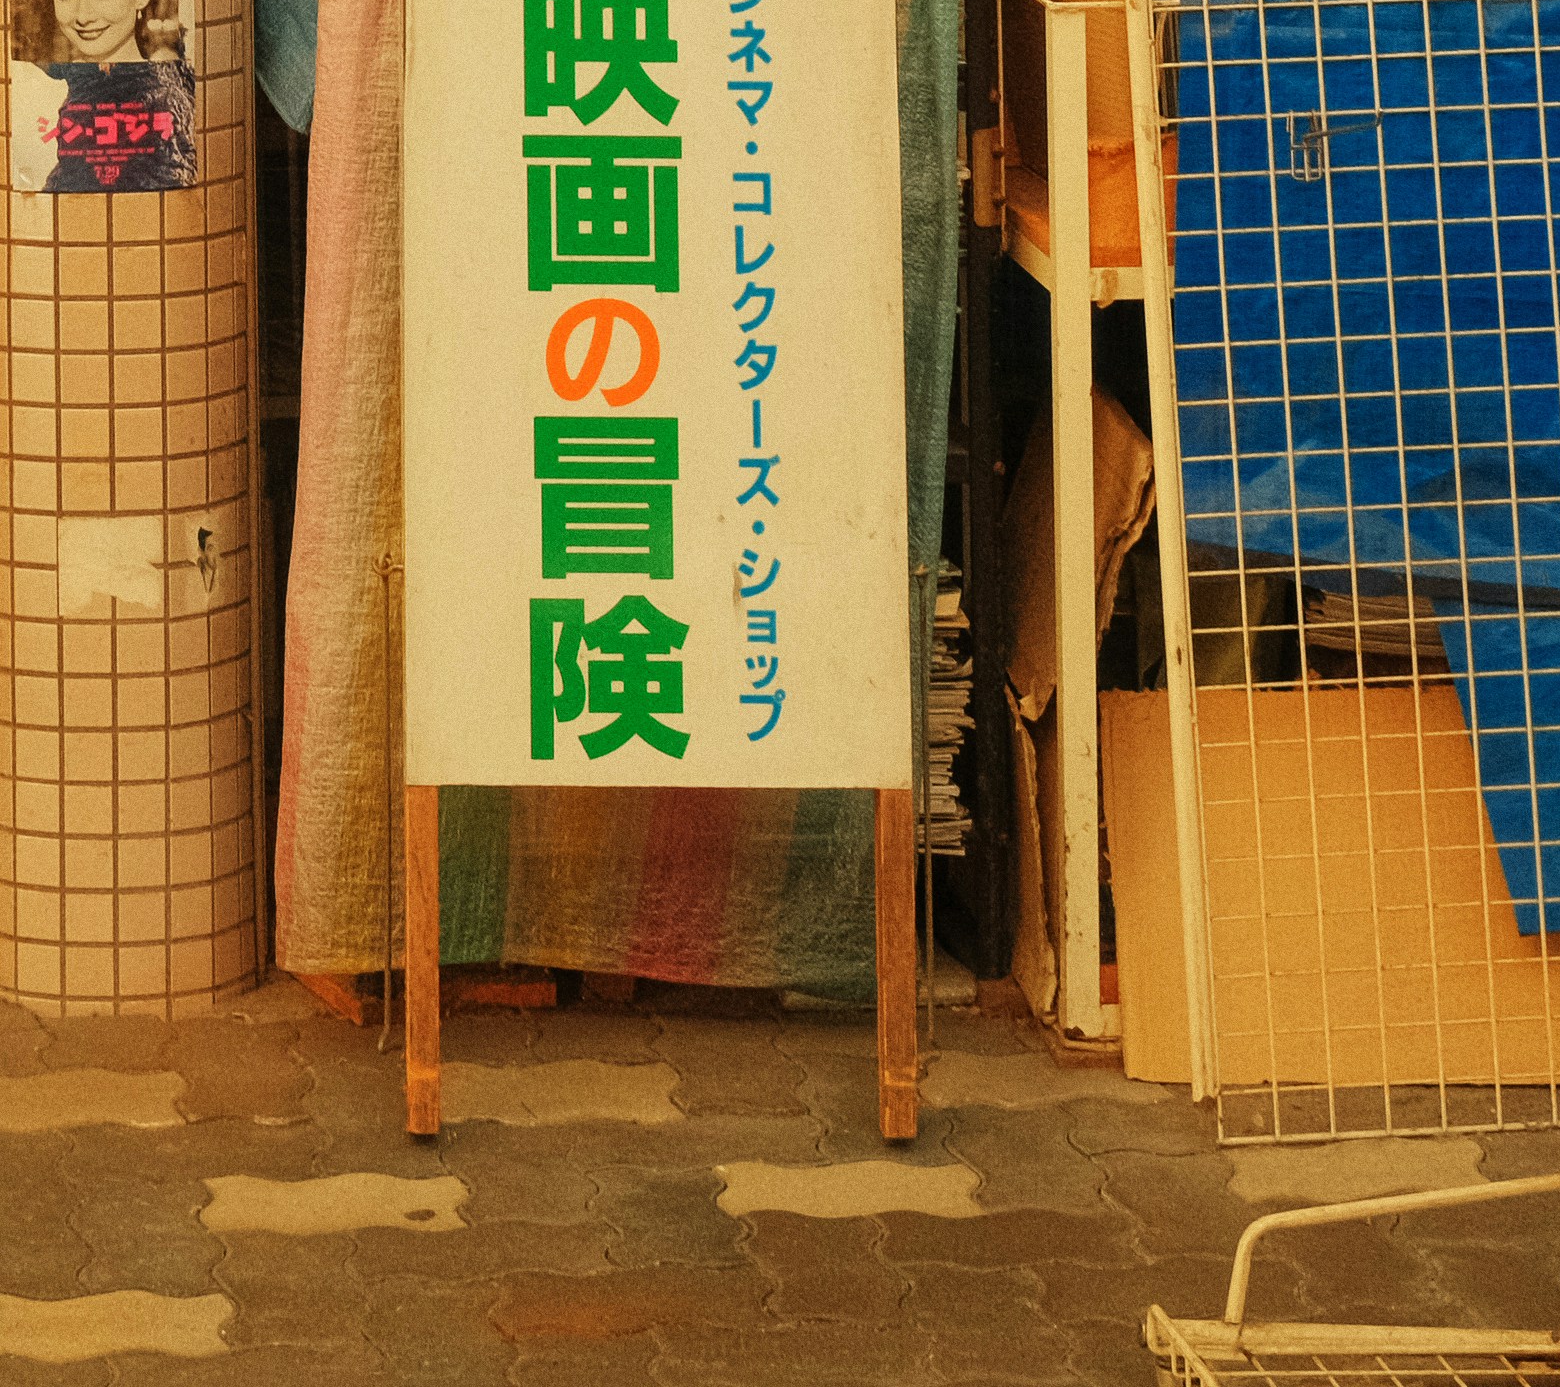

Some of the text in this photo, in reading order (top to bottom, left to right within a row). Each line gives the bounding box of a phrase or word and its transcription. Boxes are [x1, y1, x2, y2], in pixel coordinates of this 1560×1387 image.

[37, 111, 174, 143] シン・ゴジラ
